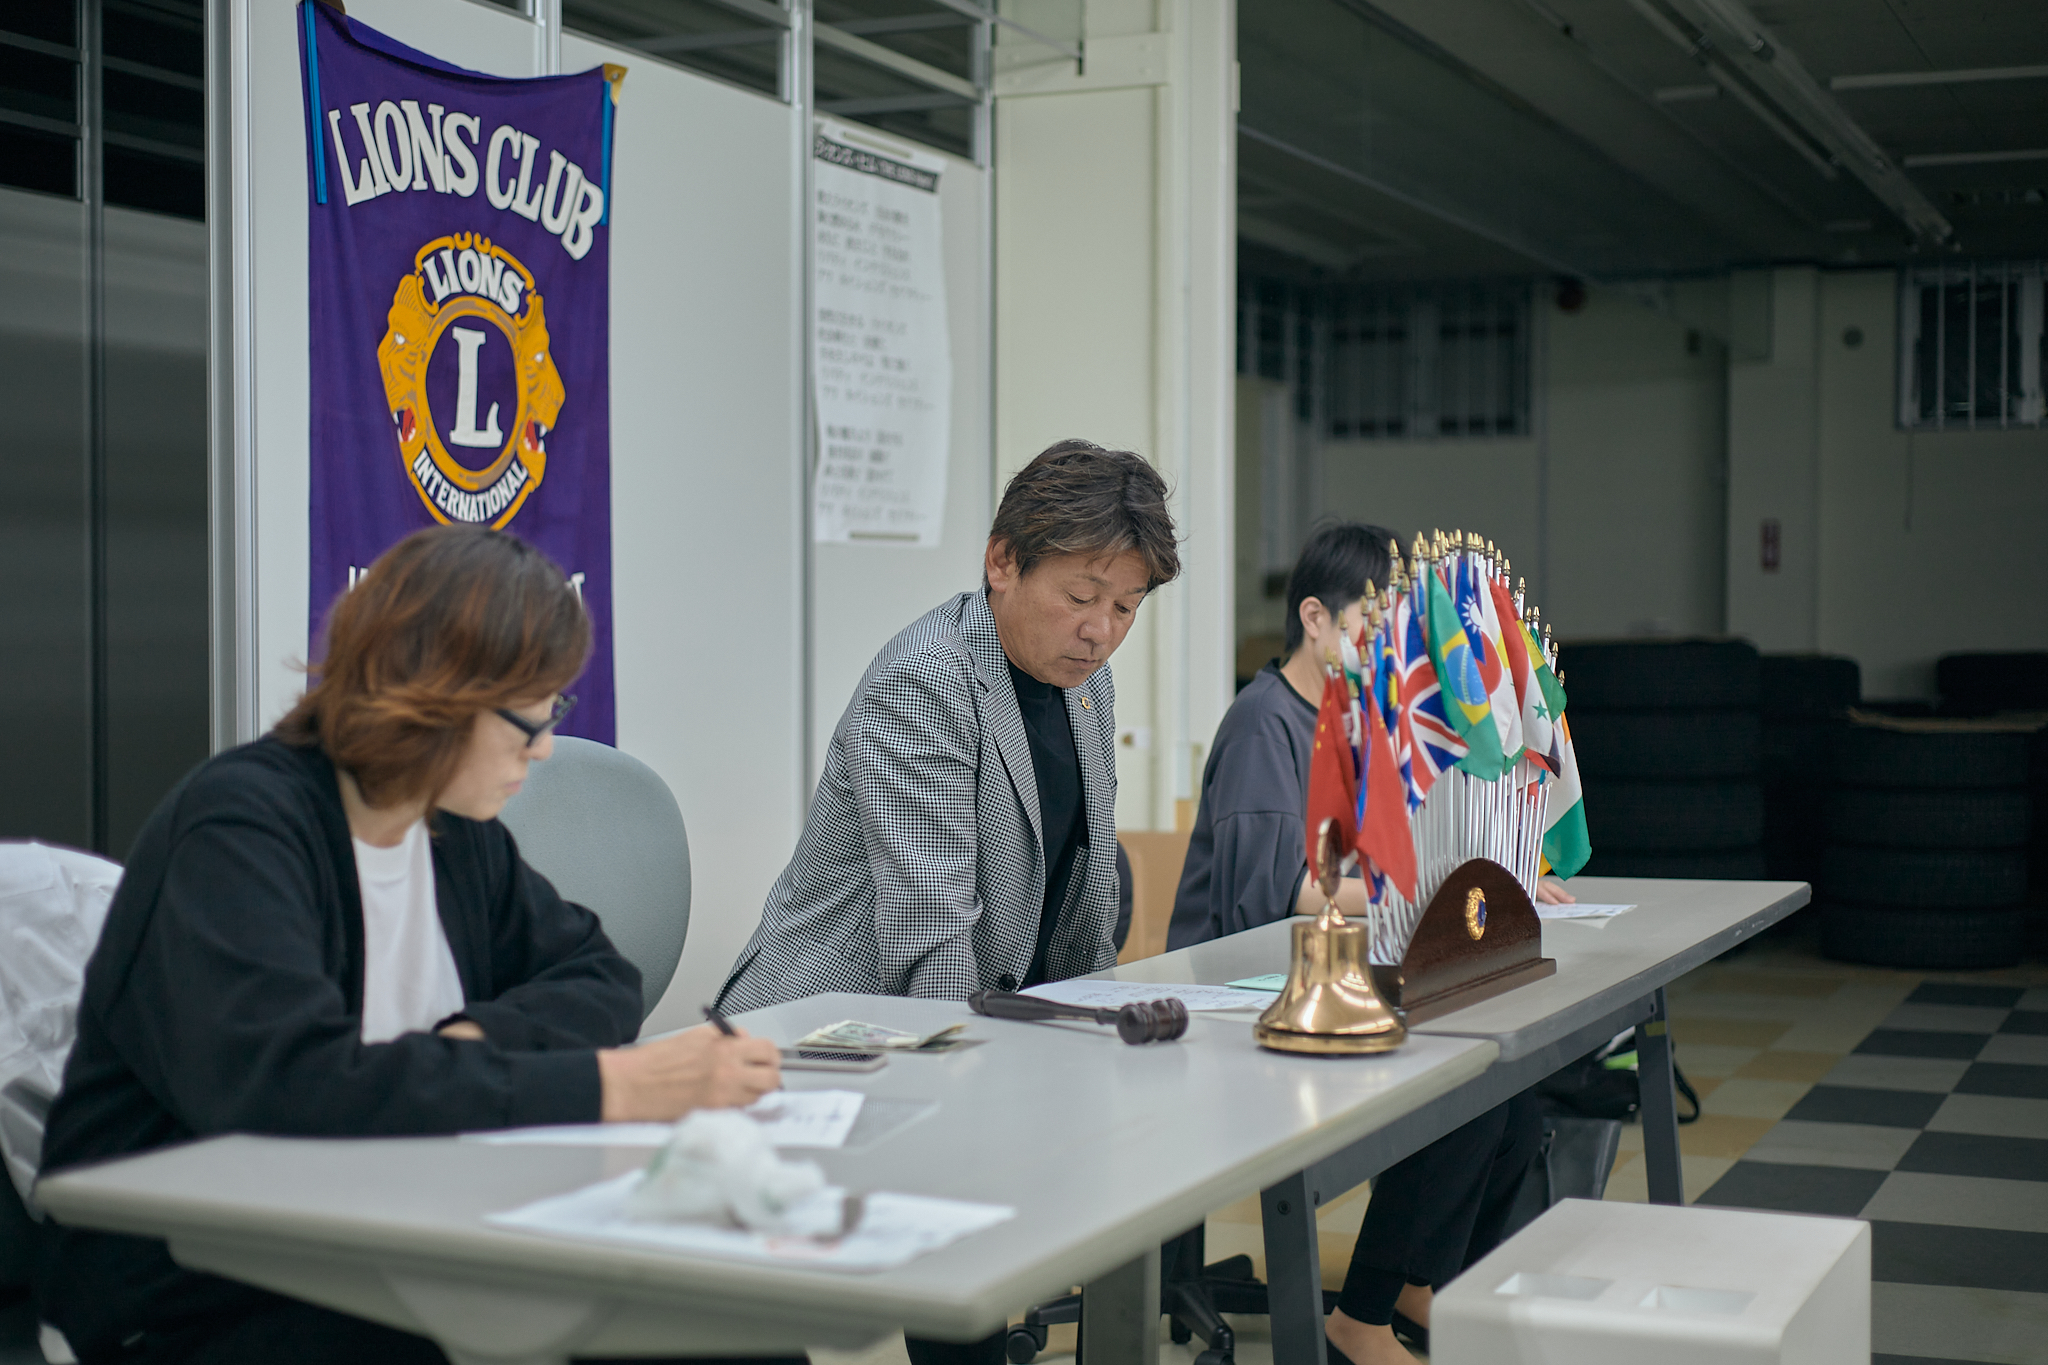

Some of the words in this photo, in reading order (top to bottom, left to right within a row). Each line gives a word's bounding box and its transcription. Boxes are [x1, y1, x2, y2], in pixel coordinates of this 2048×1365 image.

[328, 100, 481, 207] LIONS
[485, 124, 605, 261] CLUB
[422, 248, 526, 315] LIONS
[449, 326, 504, 448] L
[412, 448, 530, 524] INTERNATIONAL
